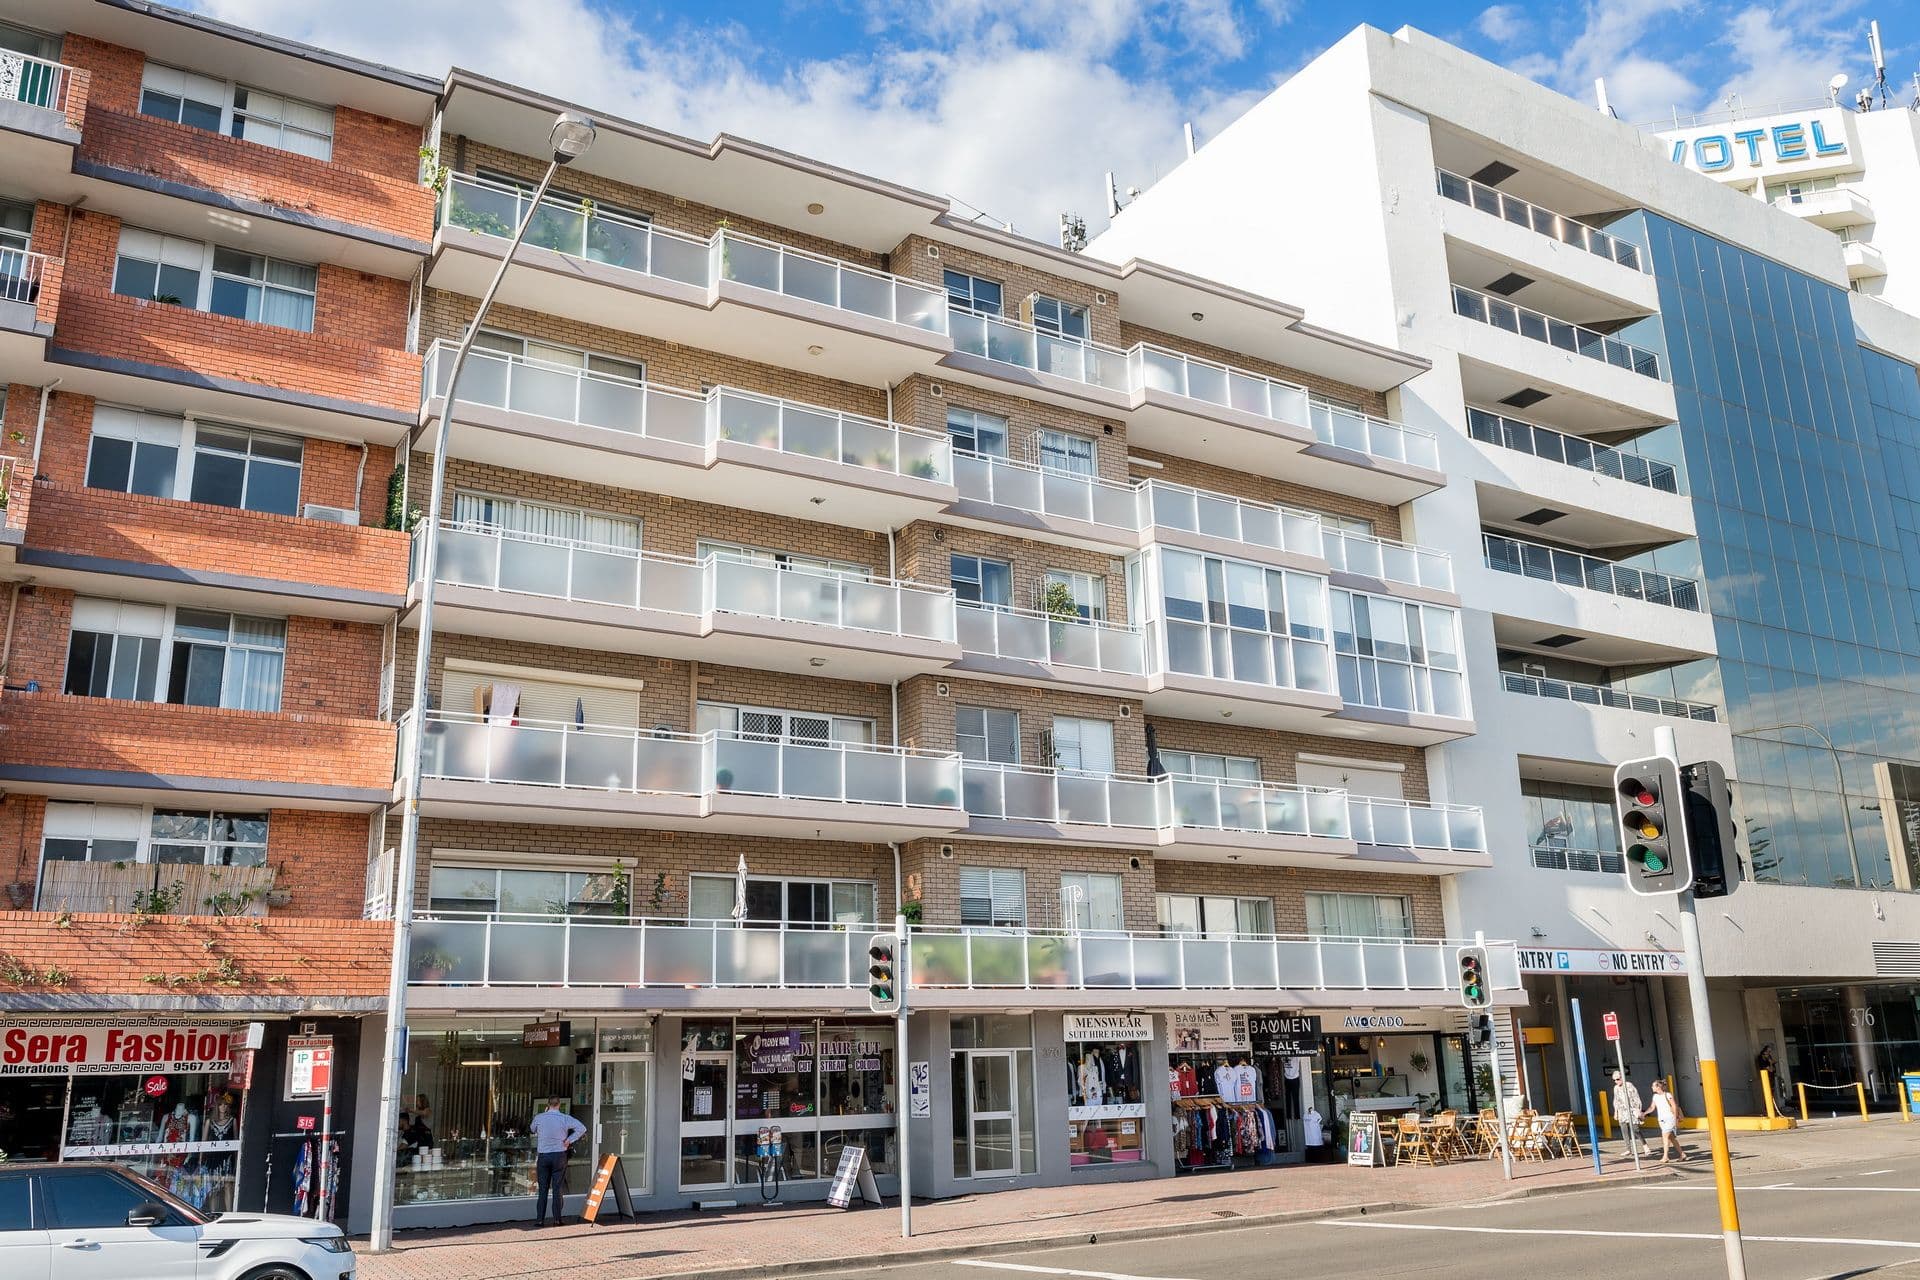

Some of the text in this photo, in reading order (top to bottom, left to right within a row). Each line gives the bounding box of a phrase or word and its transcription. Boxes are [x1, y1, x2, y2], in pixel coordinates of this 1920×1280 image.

[1612, 953, 1665, 971] NO ENTRY
[1075, 1017, 1142, 1028] MENSWEAR
[1344, 1016, 1404, 1027] AVOCADO
[1849, 1006, 1875, 1027] 376
[1068, 1030, 1148, 1039] SUIT HIRE FROM $99
[1233, 1034, 1246, 1042] $99
[3, 1029, 88, 1064] Sera
[821, 1042, 851, 1056] HAIR
[857, 1041, 882, 1055] CUT
[1270, 1041, 1300, 1051] SALE
[1, 1062, 231, 1074] Alterations 9567 273
[820, 1060, 847, 1072] STREAK
[854, 1059, 881, 1071] COLOUR
[147, 1082, 168, 1094] Sale
[299, 1118, 314, 1127] $15
